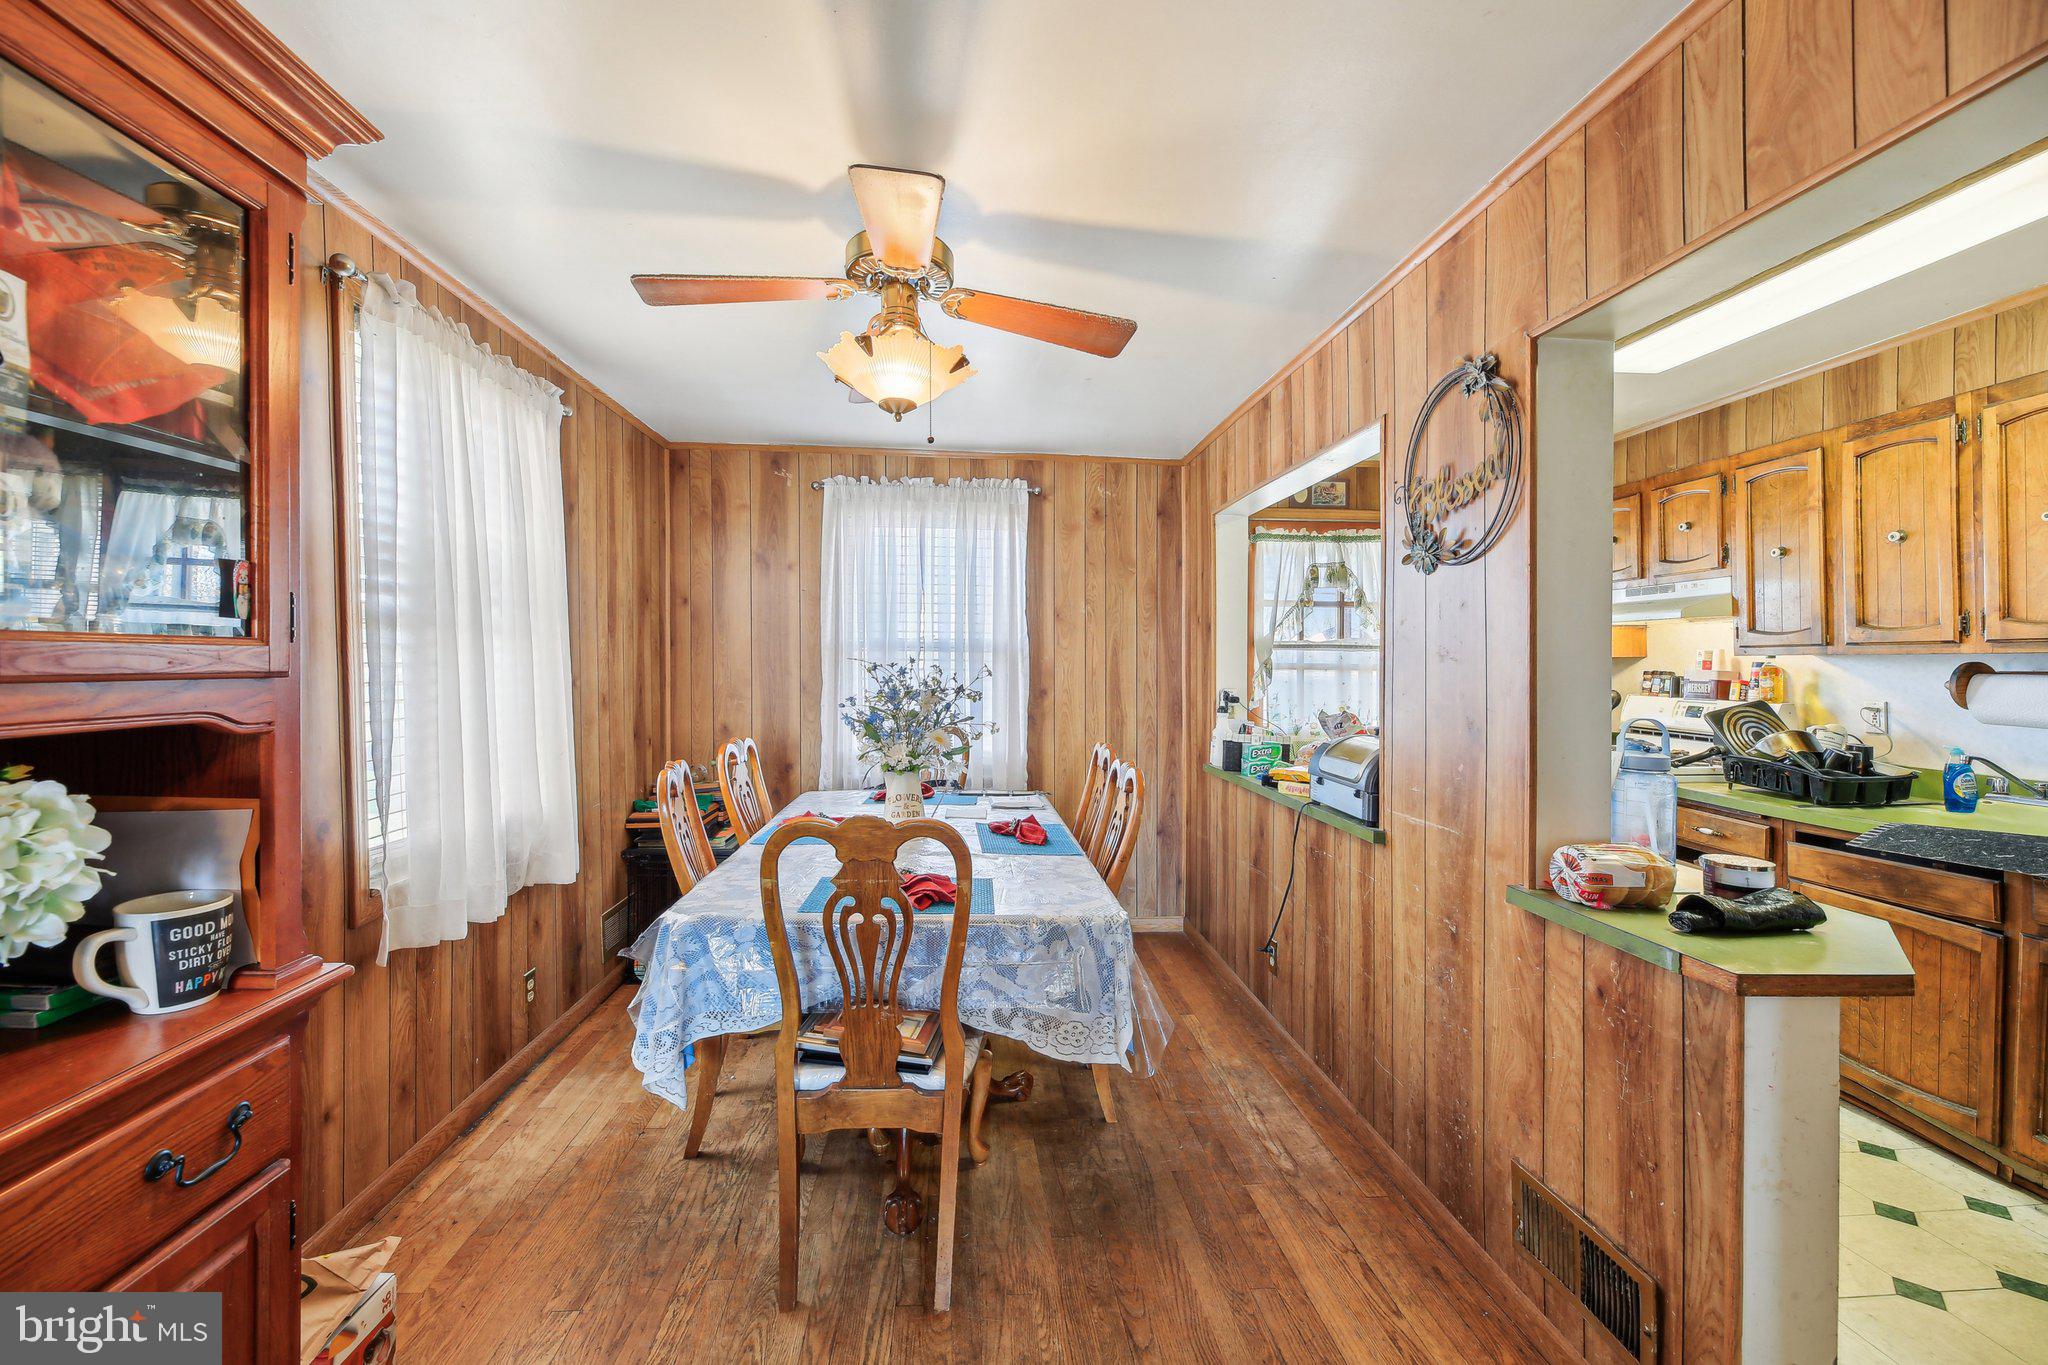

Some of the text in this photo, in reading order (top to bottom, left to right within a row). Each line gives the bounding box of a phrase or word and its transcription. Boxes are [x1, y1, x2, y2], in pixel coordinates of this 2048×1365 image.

[17, 206, 120, 244] EBA
[1409, 447, 1508, 522] Blessed
[1251, 748, 1272, 758] Extra
[891, 810, 921, 818] GARDEN
[169, 913, 234, 942] GOOD MO
[210, 930, 225, 941] HAVE
[168, 942, 213, 961] STICKY
[178, 953, 213, 970] DIRTY
[174, 971, 219, 994] HAPPY
